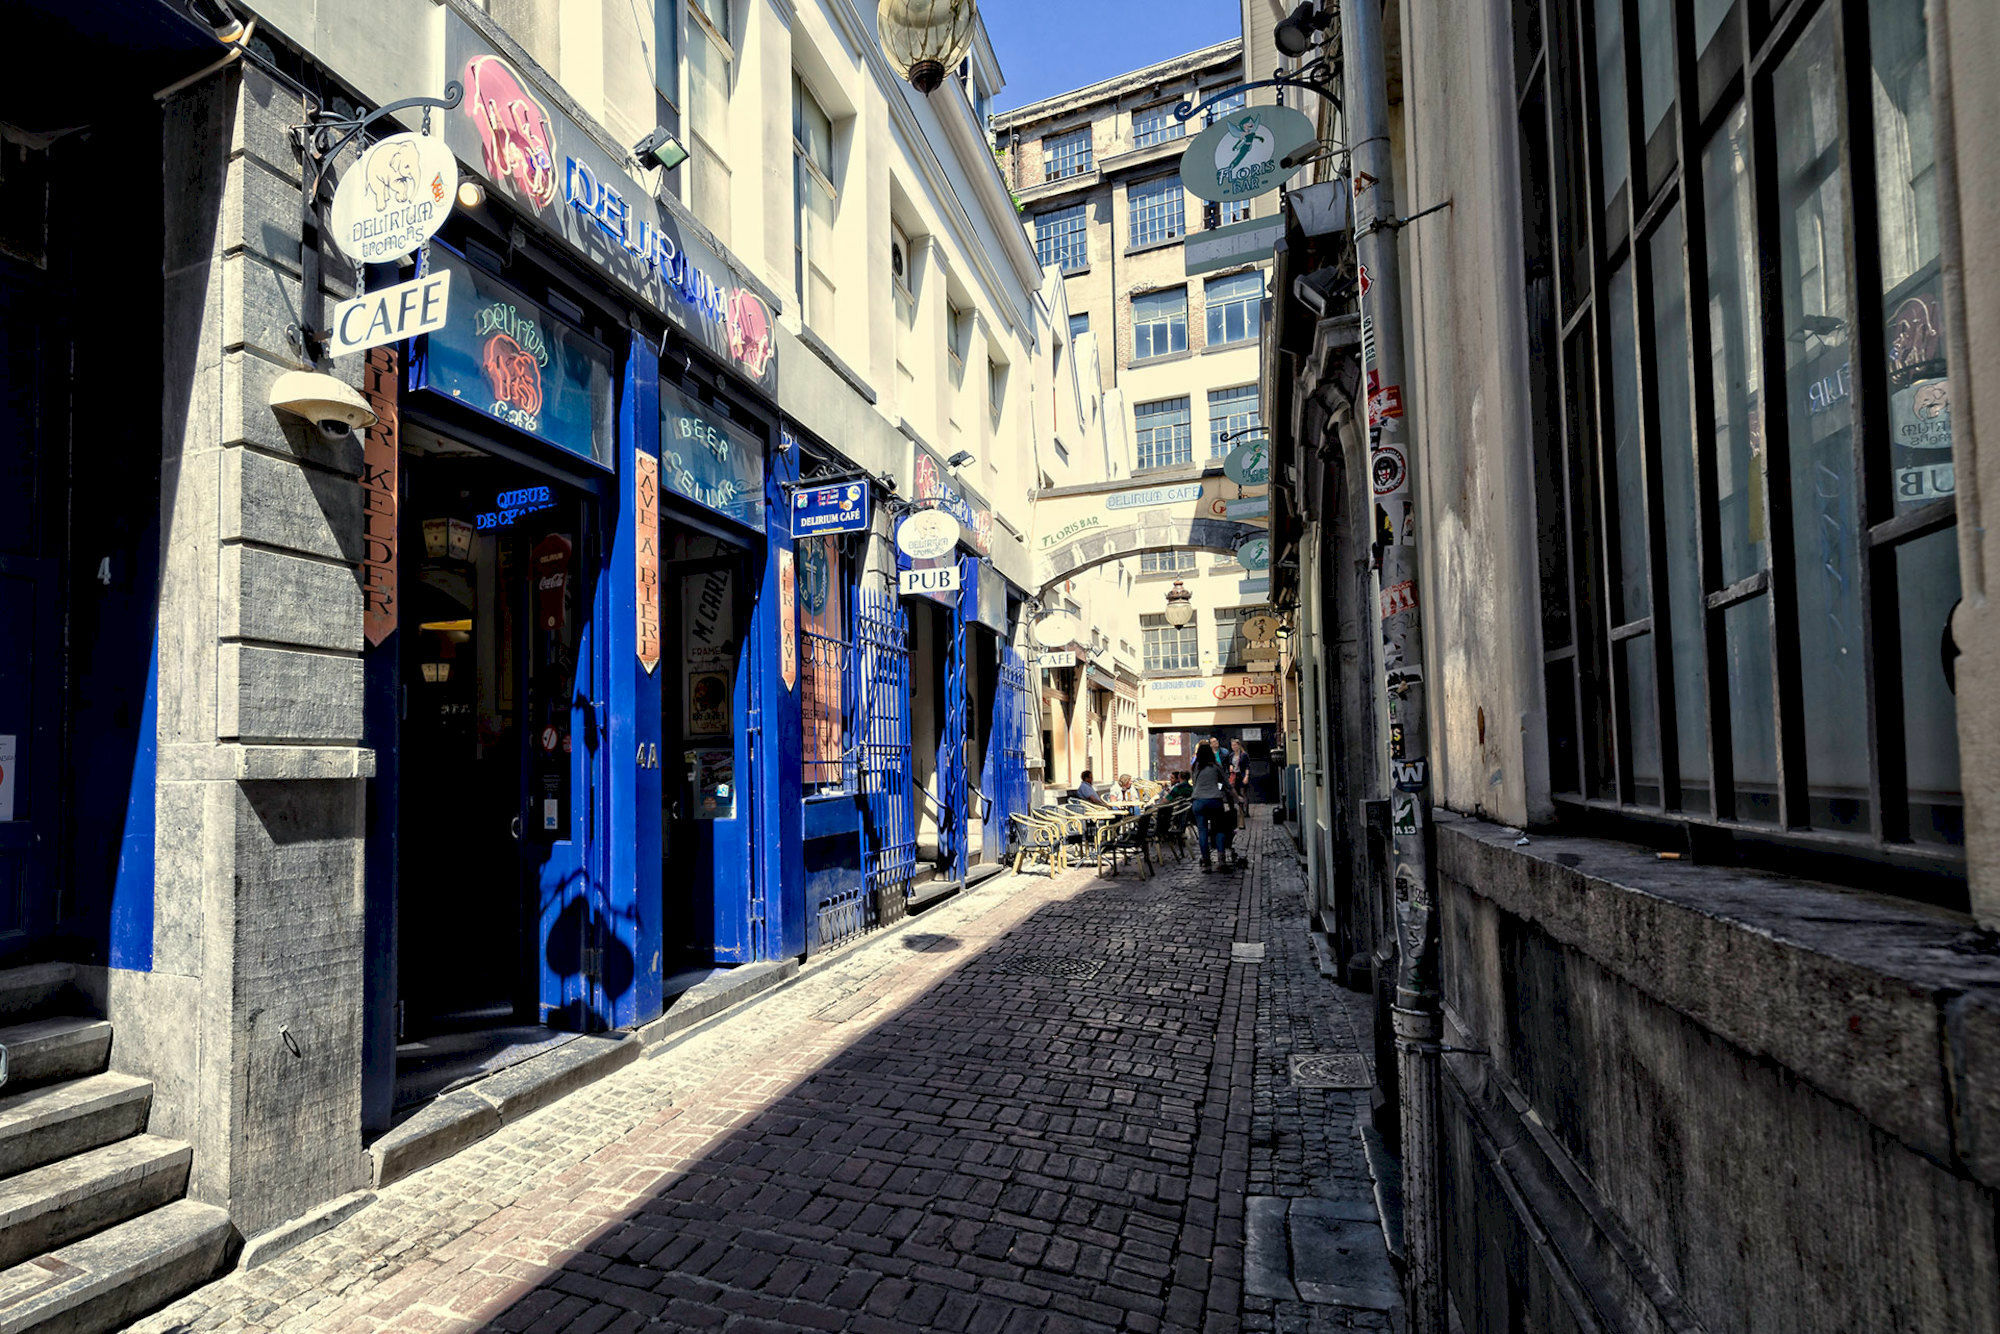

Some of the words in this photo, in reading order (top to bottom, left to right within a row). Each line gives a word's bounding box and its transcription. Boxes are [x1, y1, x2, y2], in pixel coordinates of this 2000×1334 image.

[1217, 159, 1275, 186] FLORIS
[1232, 179, 1259, 195] BAR
[353, 201, 433, 242] DELIRIUM
[362, 226, 425, 257] tremens
[566, 156, 729, 324] DELIRIUM
[340, 280, 441, 347] CAFE
[680, 418, 728, 461] BEER
[639, 457, 656, 529] CAVE
[671, 452, 737, 509] CELLAR
[497, 486, 549, 508] QUEUE
[1108, 491, 1162, 507] DELIRIUM
[1168, 487, 1198, 500] CAFE
[801, 514, 839, 527] DELIRIUM
[840, 508, 860, 521] CAFÉ
[1042, 523, 1079, 547] FLORIS
[1080, 516, 1099, 528] BAR
[362, 463, 394, 616] KELDER
[98, 556, 112, 585] 4
[909, 571, 950, 590] PUB
[1040, 654, 1073, 666] CAFE
[636, 743, 659, 769] 4A
